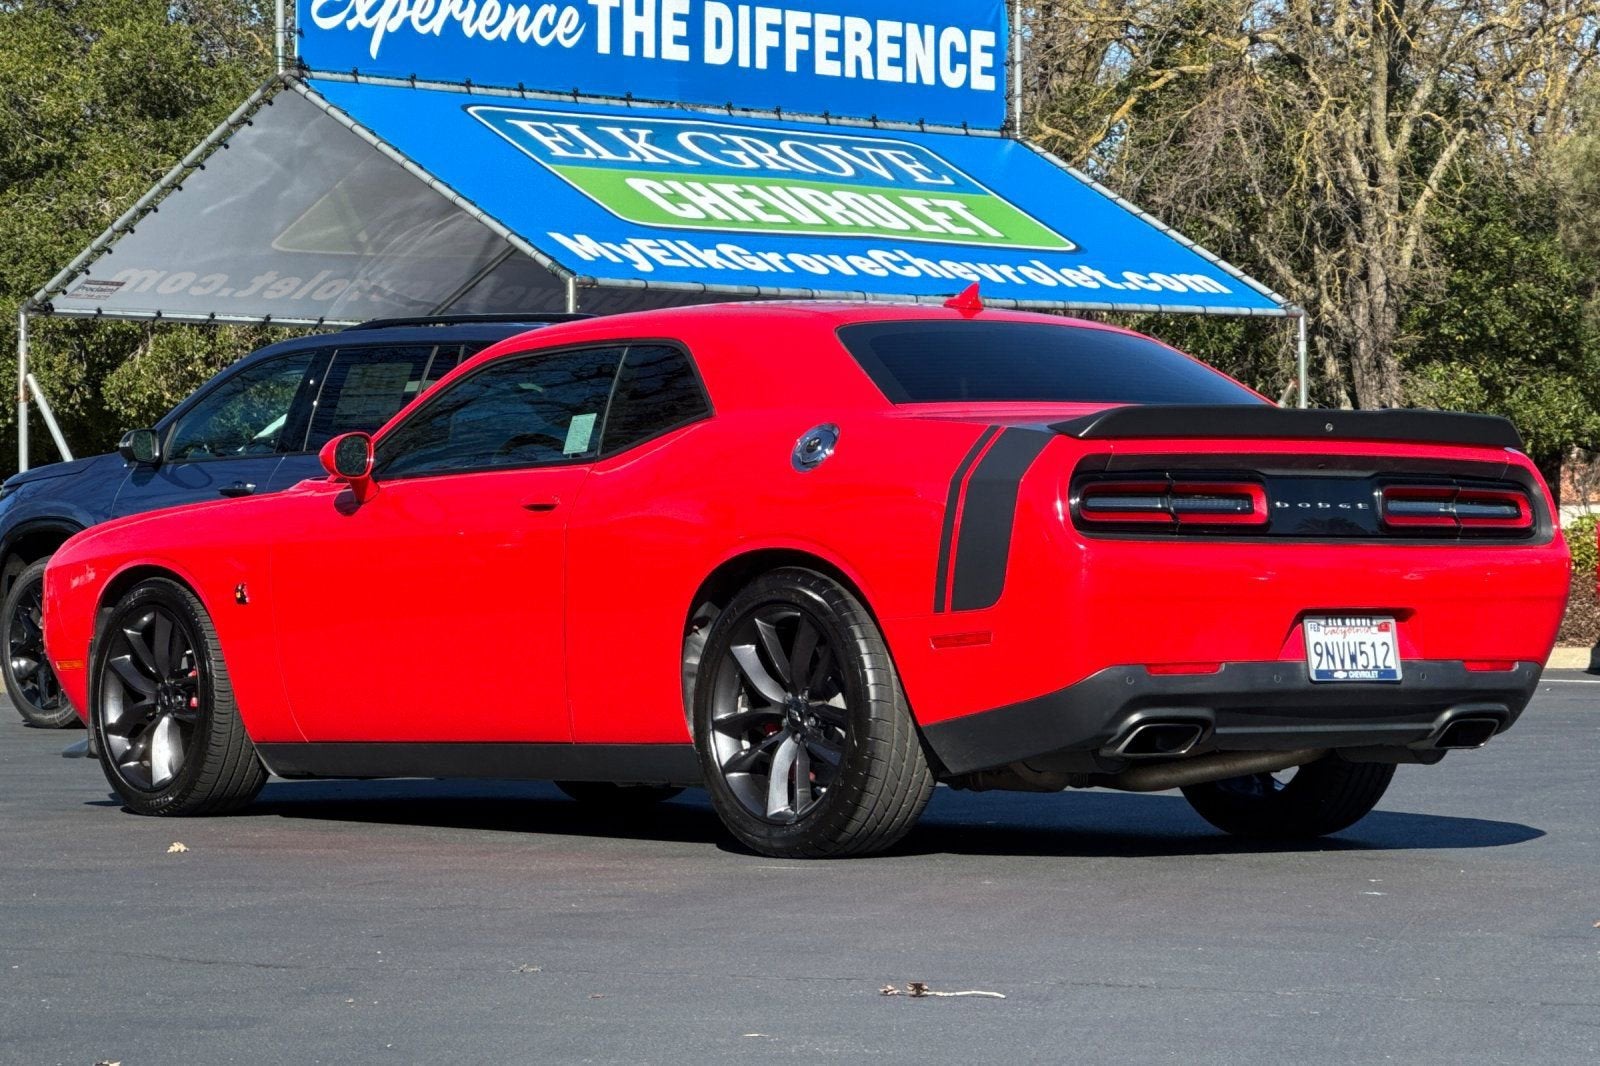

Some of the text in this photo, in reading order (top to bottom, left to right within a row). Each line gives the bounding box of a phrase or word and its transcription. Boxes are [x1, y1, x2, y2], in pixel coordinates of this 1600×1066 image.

[588, 0, 690, 62] THE
[703, 1, 996, 92] DIFFERENCE
[505, 118, 955, 186] ELK GROVE
[625, 177, 1005, 238] CHEVROLET
[547, 231, 1234, 295] MyElkGroveChevrolet.com
[1313, 641, 1392, 669] 9NVW512
